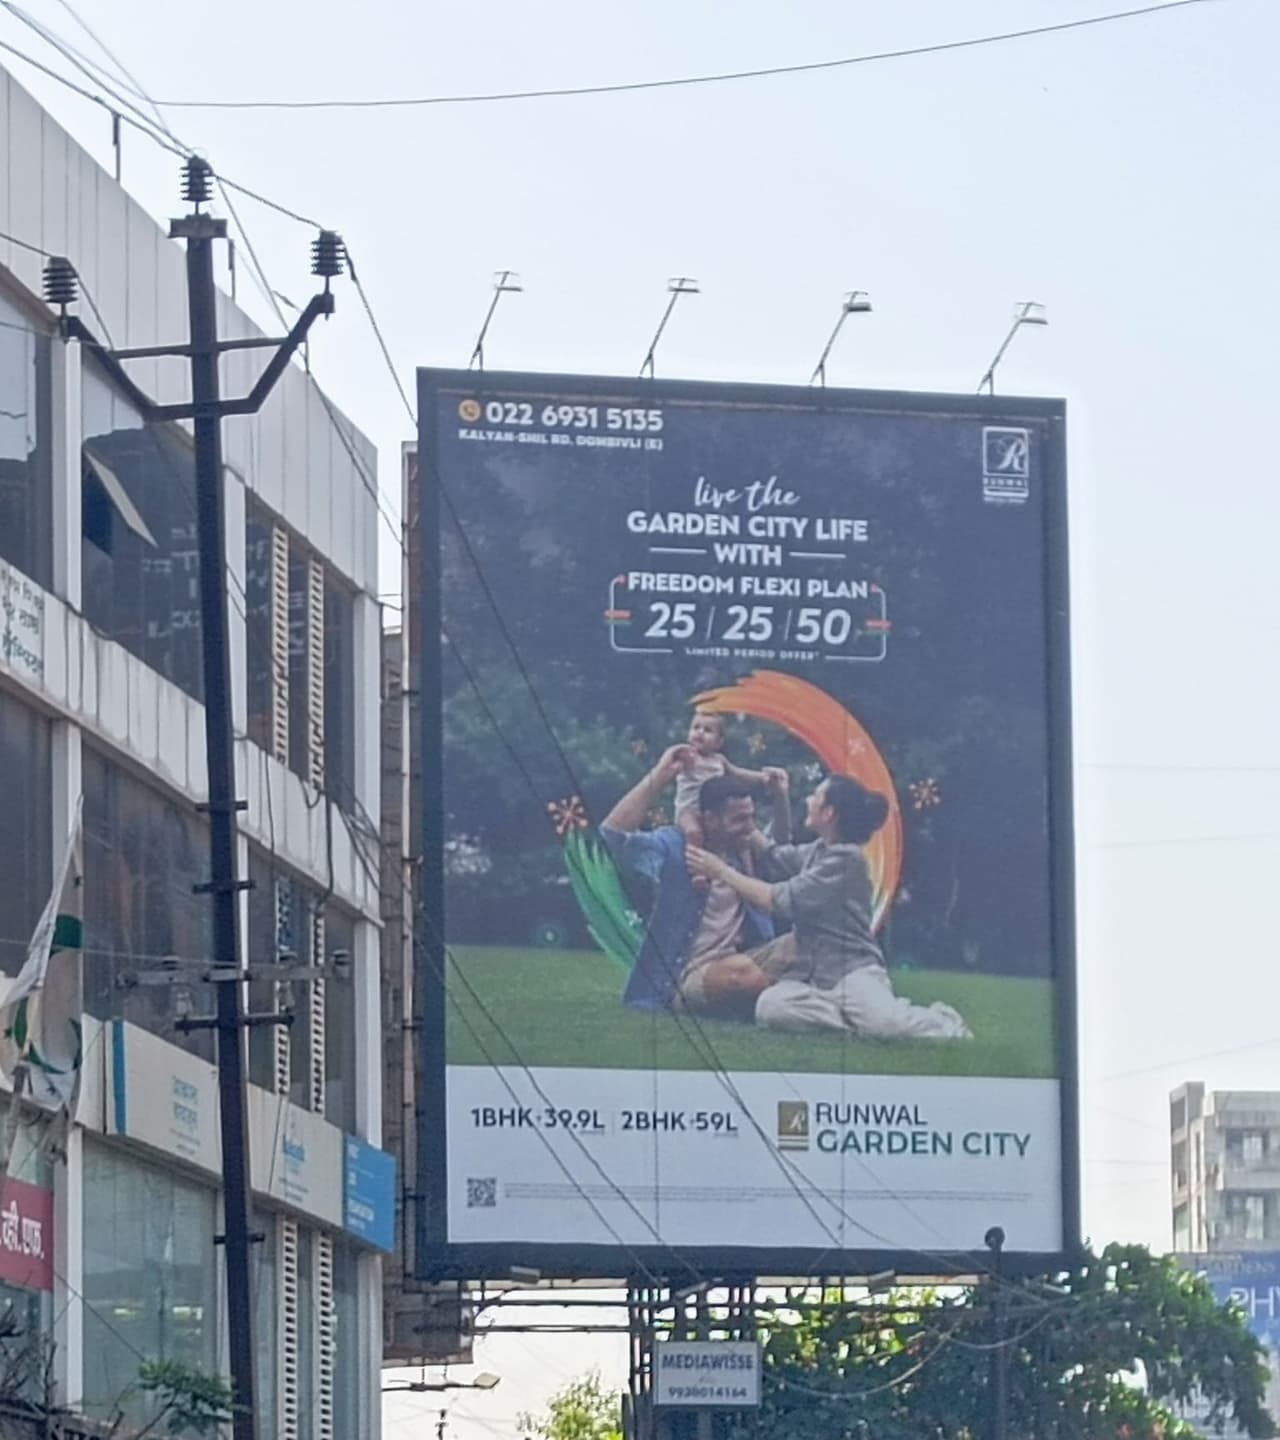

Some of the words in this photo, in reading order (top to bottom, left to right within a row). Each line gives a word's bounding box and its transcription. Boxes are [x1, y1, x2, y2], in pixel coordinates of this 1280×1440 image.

[485, 401, 534, 425] 022
[541, 405, 599, 428] 6931
[606, 408, 664, 431] 5135
[693, 476, 742, 509] live
[743, 475, 801, 512] the
[626, 510, 740, 537] GARDEN
[747, 515, 808, 539] CITY
[815, 518, 869, 542] LIFE
[713, 542, 783, 567] WITH
[627, 571, 734, 595] FREEDOM
[740, 576, 801, 597] FLEXI
[807, 579, 869, 600] PLAN
[644, 602, 697, 639] 25
[721, 605, 774, 642] 25
[795, 608, 852, 645] 50
[815, 1102, 928, 1126] RUNWAL
[816, 1129, 953, 1155] GARDEN
[962, 1132, 1032, 1157] CITY
